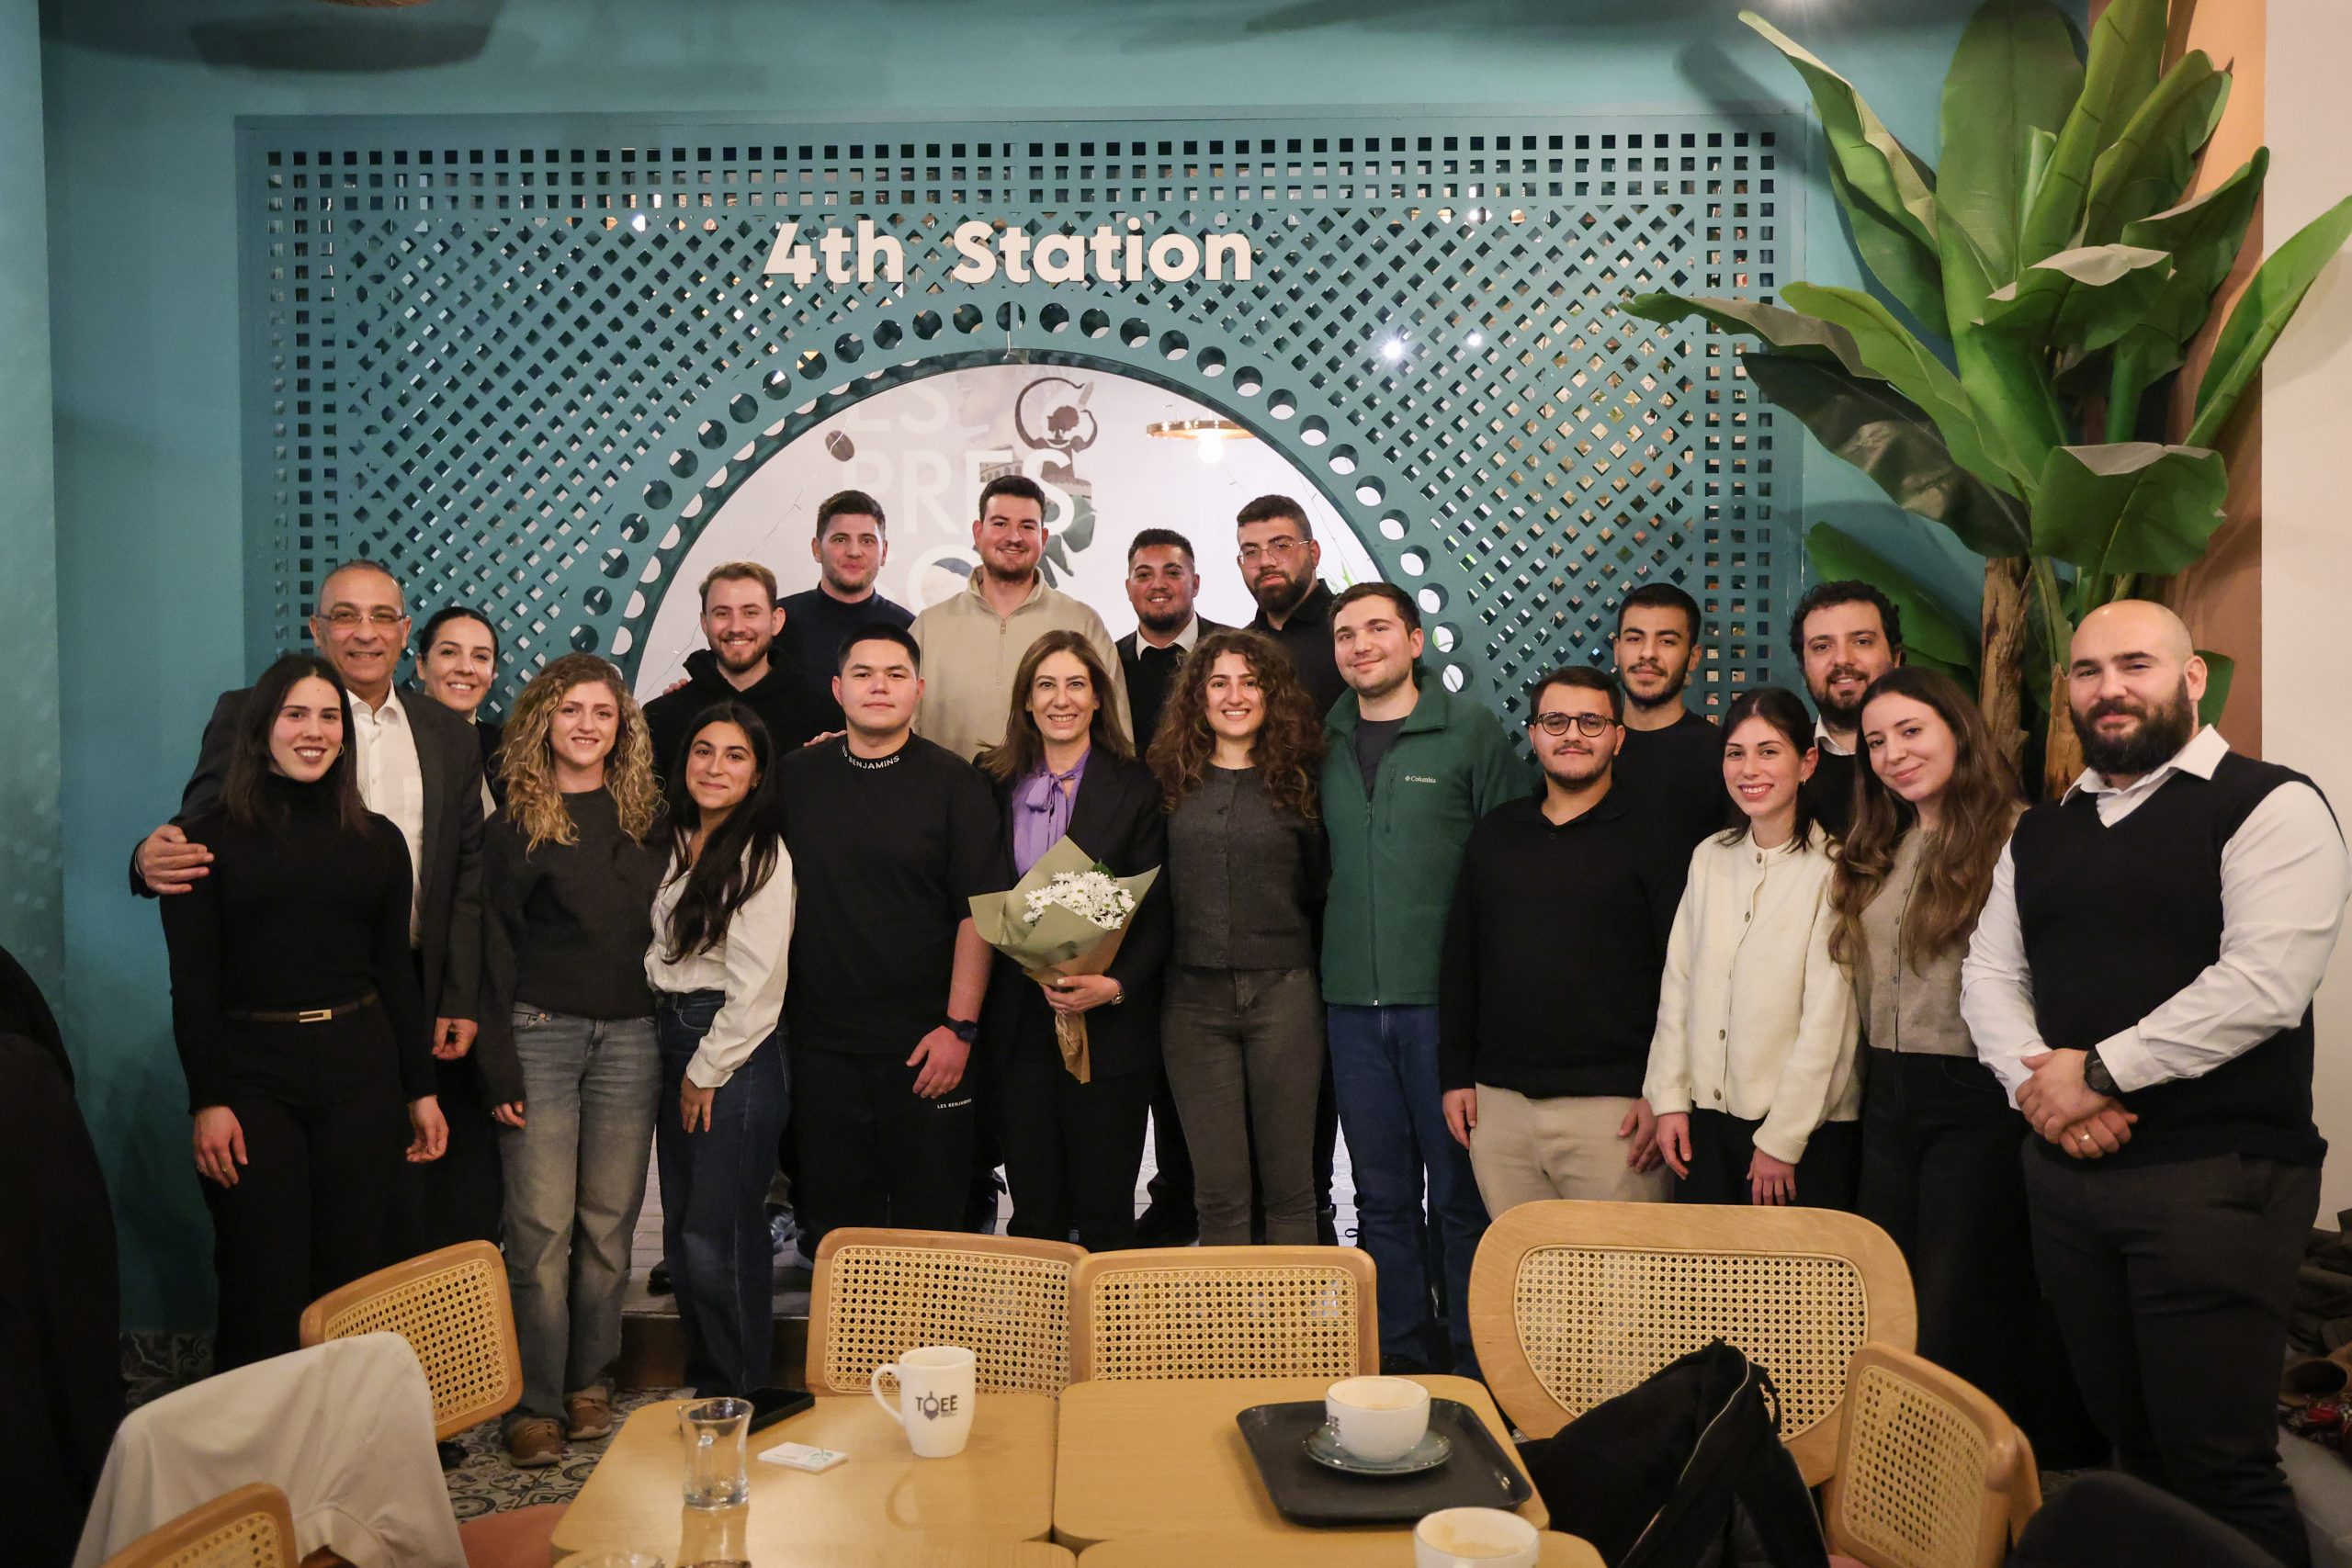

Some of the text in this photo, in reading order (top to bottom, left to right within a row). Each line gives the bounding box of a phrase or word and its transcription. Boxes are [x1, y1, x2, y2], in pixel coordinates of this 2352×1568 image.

[763, 217, 1252, 284] 4th Station
[848, 755, 899, 769] BENJAMINS
